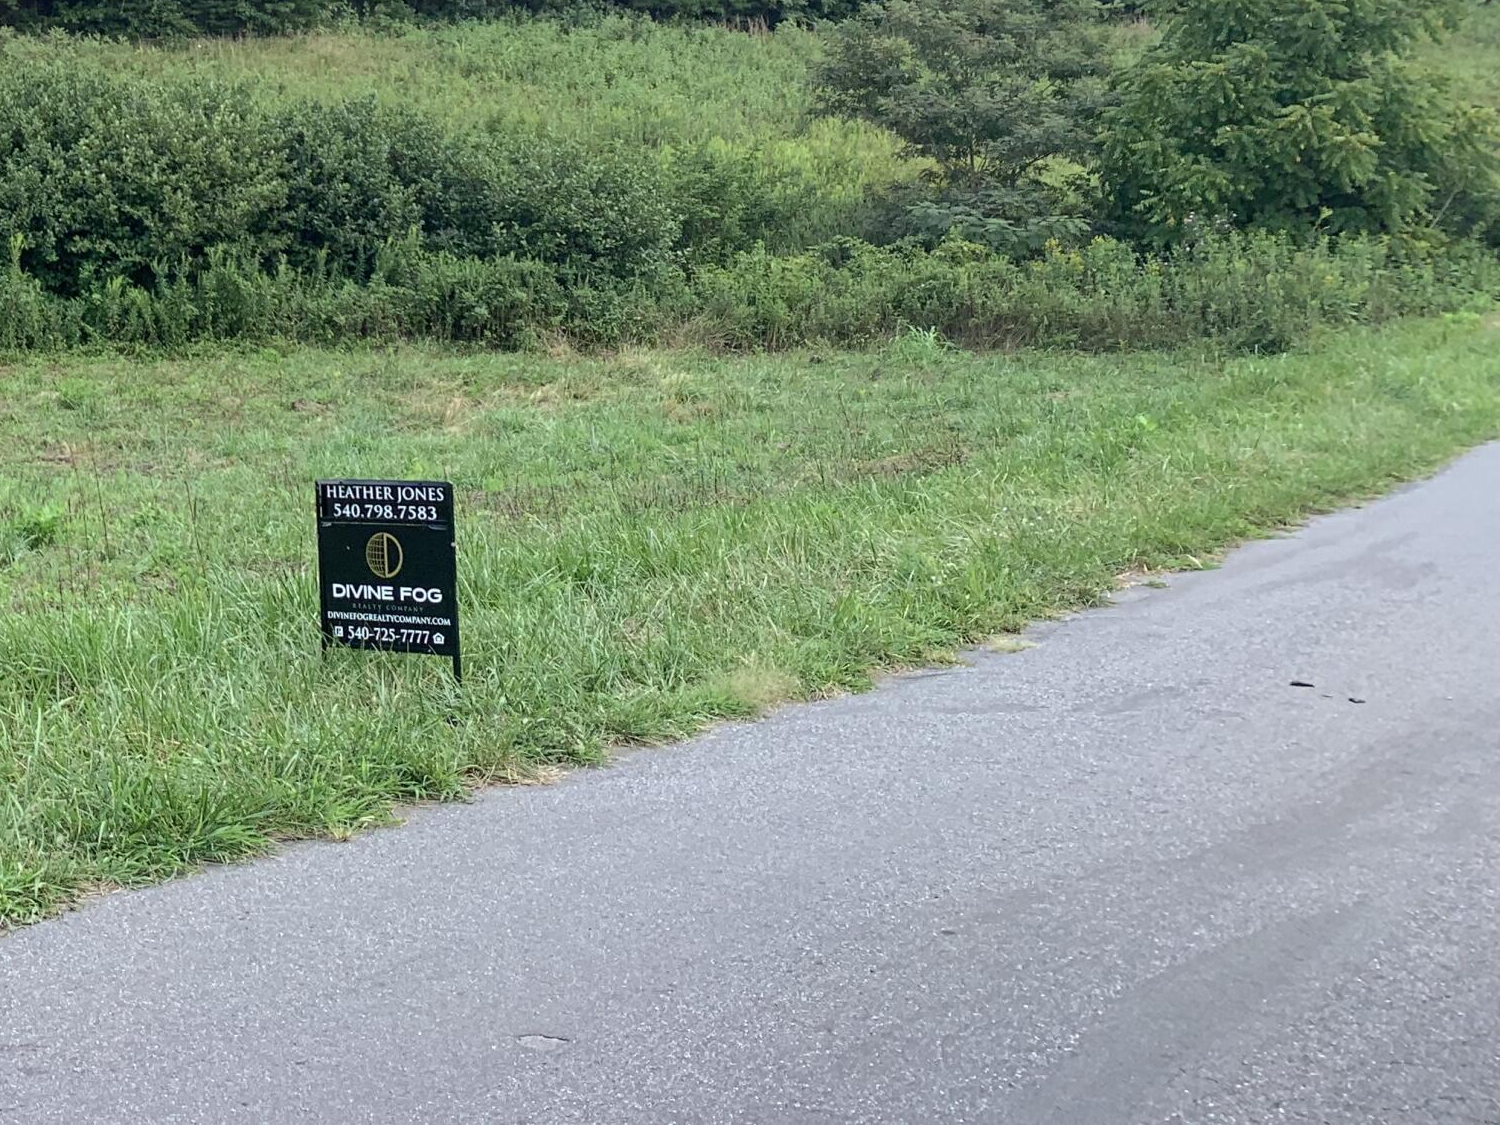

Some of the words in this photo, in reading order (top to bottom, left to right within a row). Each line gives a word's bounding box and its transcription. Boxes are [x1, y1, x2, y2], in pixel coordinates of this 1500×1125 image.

[326, 485, 394, 500] HEATHER
[397, 486, 444, 503] JONES
[333, 503, 437, 520] 540.798.7583
[332, 583, 394, 601] DIVINE
[400, 586, 443, 603] FOG
[327, 610, 451, 626] DIVINEFOGREALTYCOMPANY.COM
[347, 625, 430, 644] 540-725-7777
